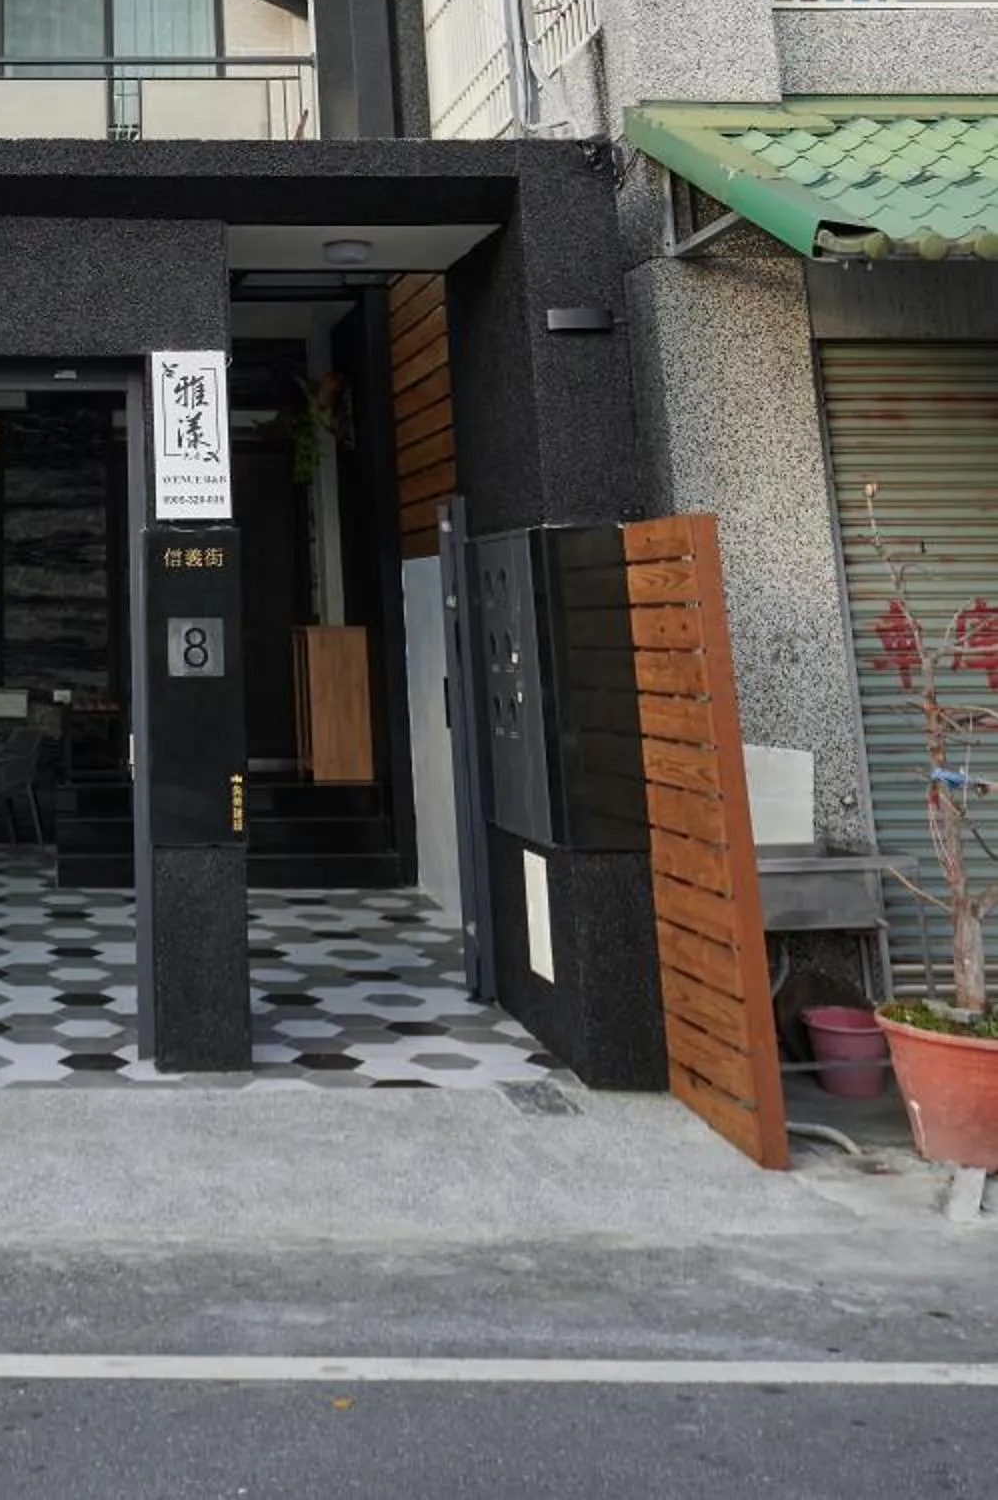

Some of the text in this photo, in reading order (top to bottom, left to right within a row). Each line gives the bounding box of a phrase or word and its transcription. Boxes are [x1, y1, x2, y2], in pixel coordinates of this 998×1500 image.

[164, 548, 224, 567] 信義街
[184, 627, 209, 668] 8
